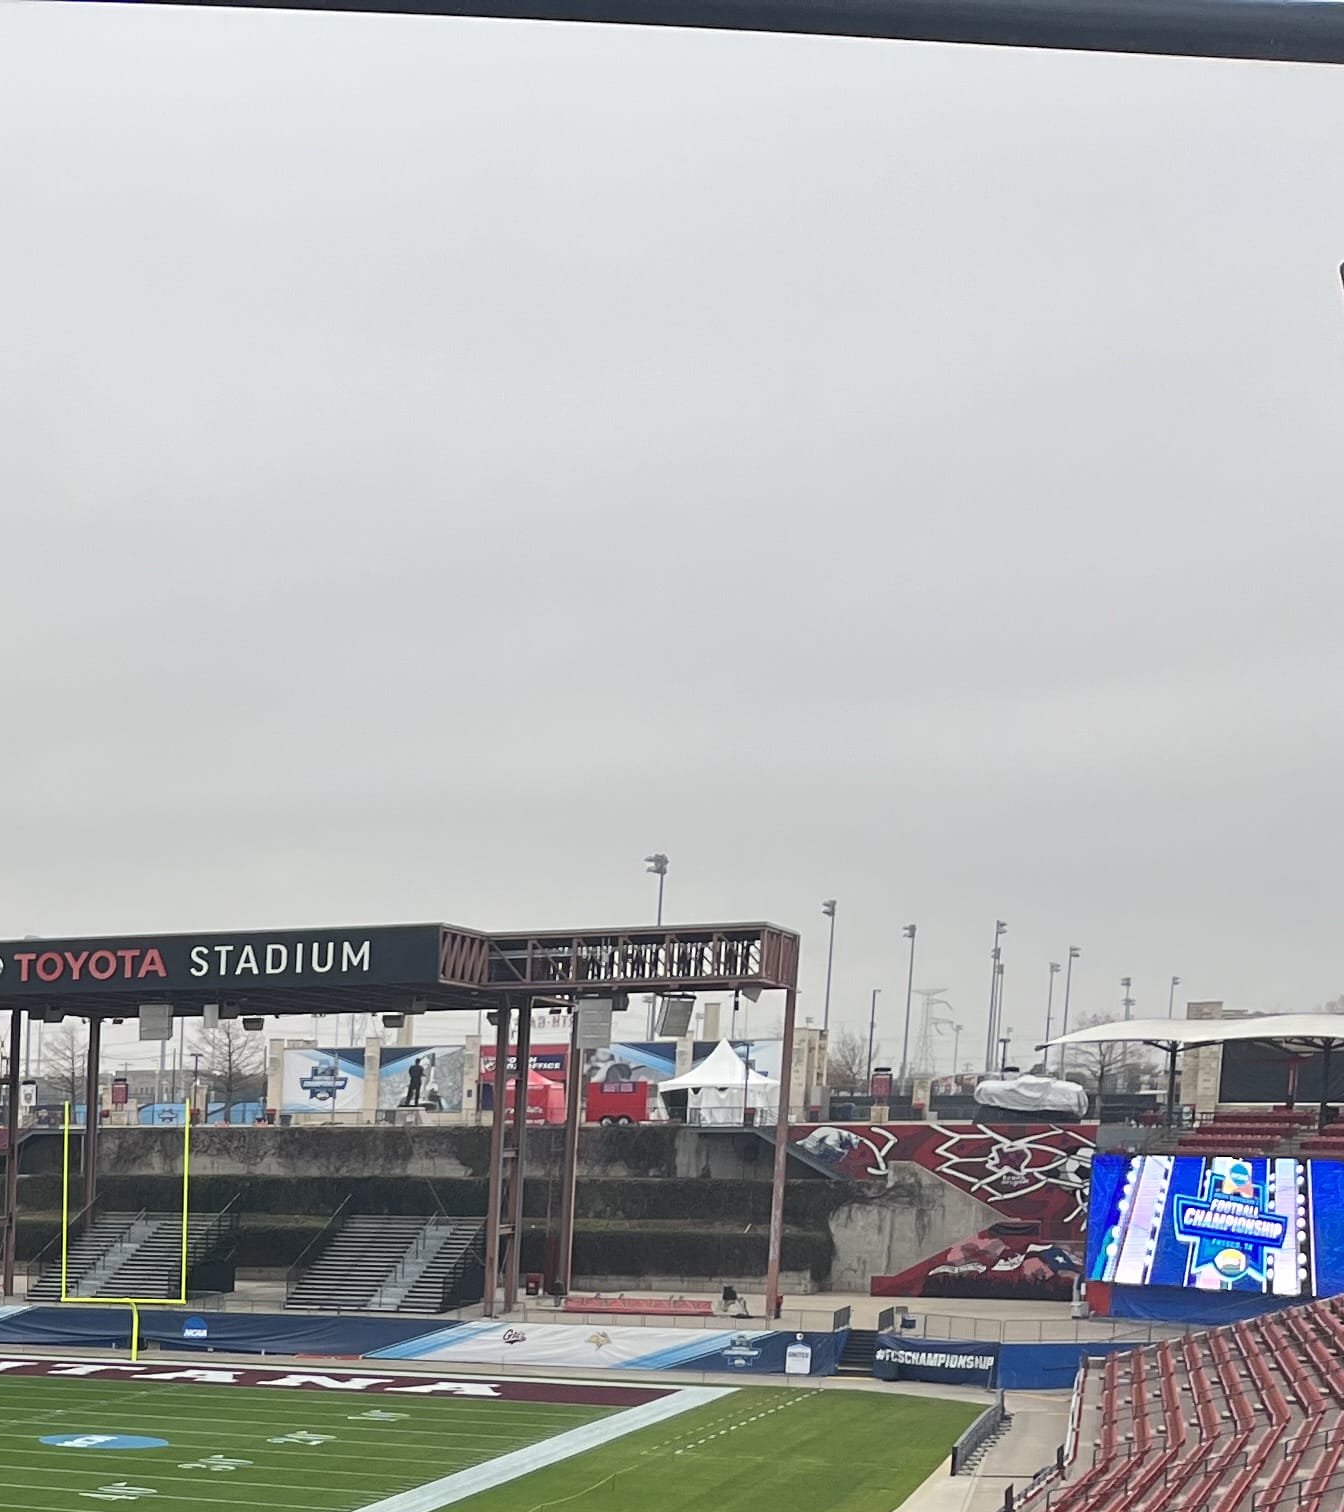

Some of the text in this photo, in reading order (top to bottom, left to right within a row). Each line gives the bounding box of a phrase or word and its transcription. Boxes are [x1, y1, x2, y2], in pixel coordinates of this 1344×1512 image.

[14, 940, 371, 982] TOYOTA STADIUM
[1209, 1198, 1260, 1219] FOOTBALL
[1183, 1207, 1283, 1239] CHAMPIONSHIP
[183, 1327, 208, 1338] NCAA
[875, 1348, 995, 1371] #FCSCHAMPIONSHIP
